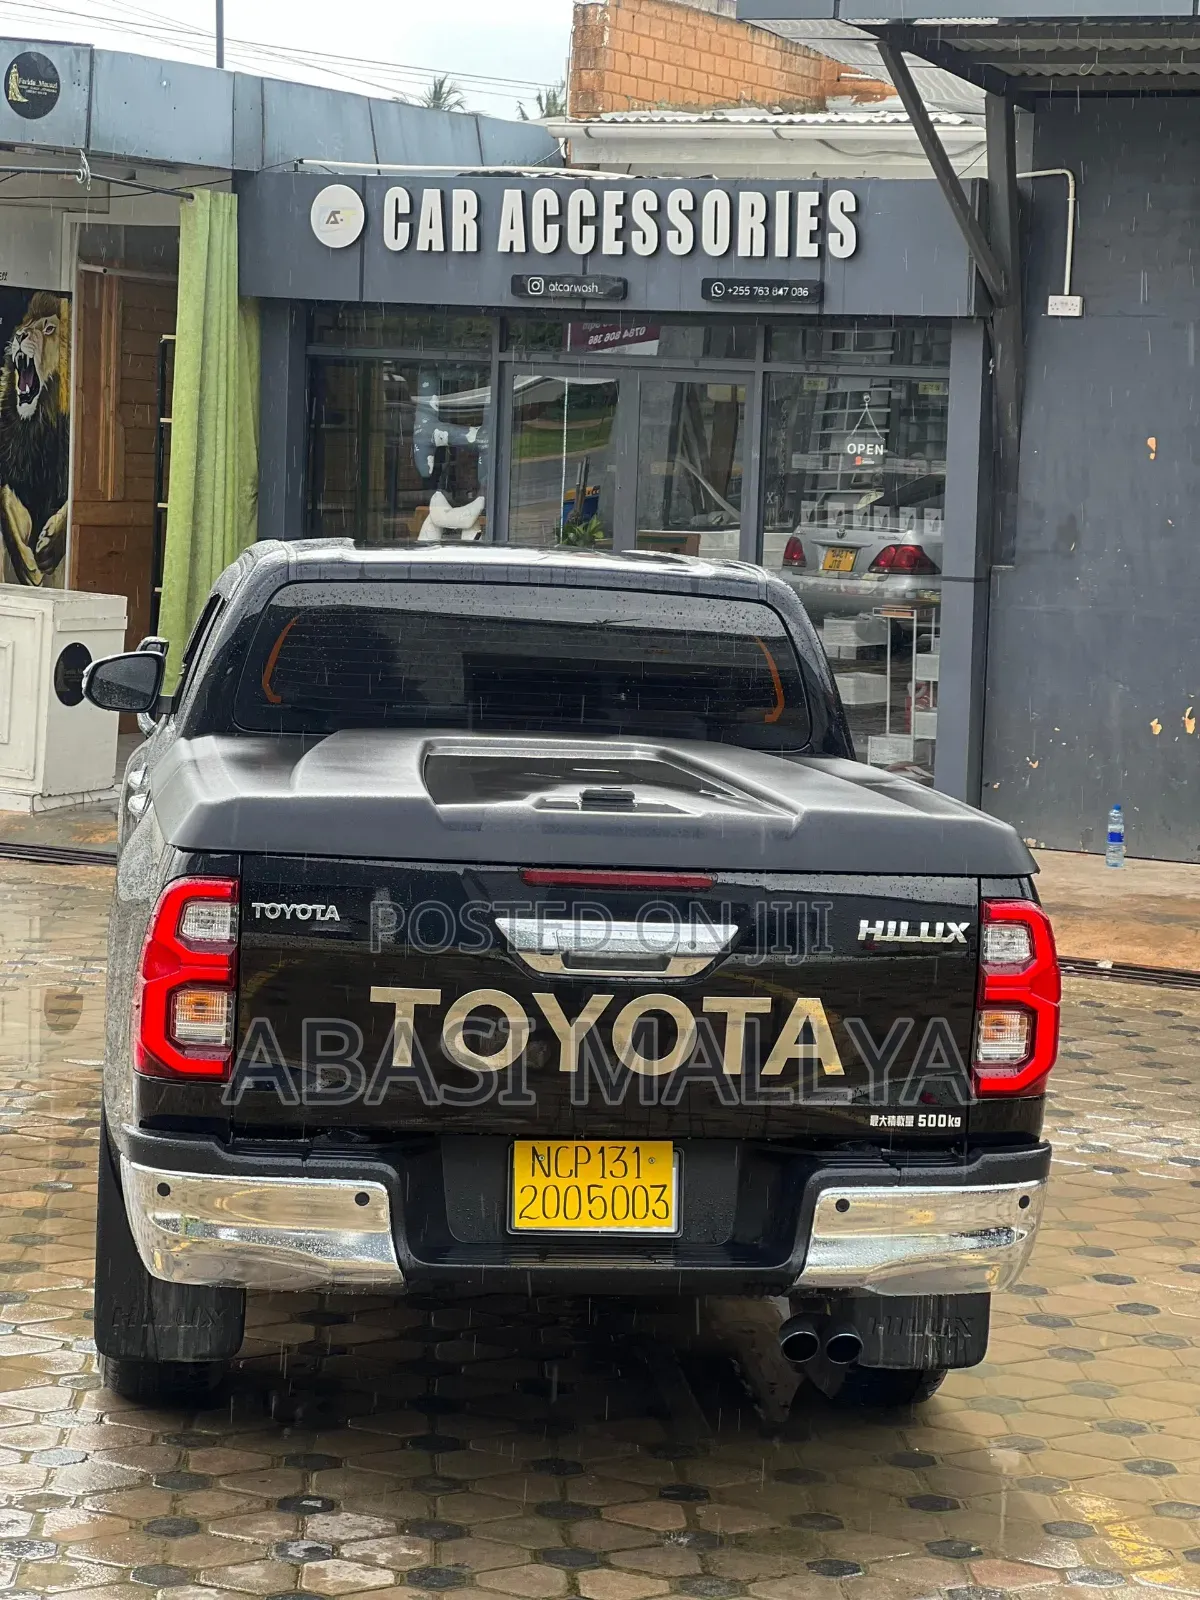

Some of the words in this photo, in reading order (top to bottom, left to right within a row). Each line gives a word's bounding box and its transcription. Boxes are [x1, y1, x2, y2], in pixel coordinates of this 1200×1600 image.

[384, 186, 479, 252] CAR
[497, 187, 858, 260] ACCESSORIES
[727, 286, 751, 295] +255
[753, 286, 770, 296] 763
[771, 286, 789, 296] 847
[847, 443, 884, 456] OPEN
[252, 902, 341, 921] TOYOTA
[857, 919, 971, 944] HILUX
[370, 986, 846, 1076] TOYOTA
[917, 1114, 962, 1128] 500kg
[518, 1184, 670, 1221] 2005003
